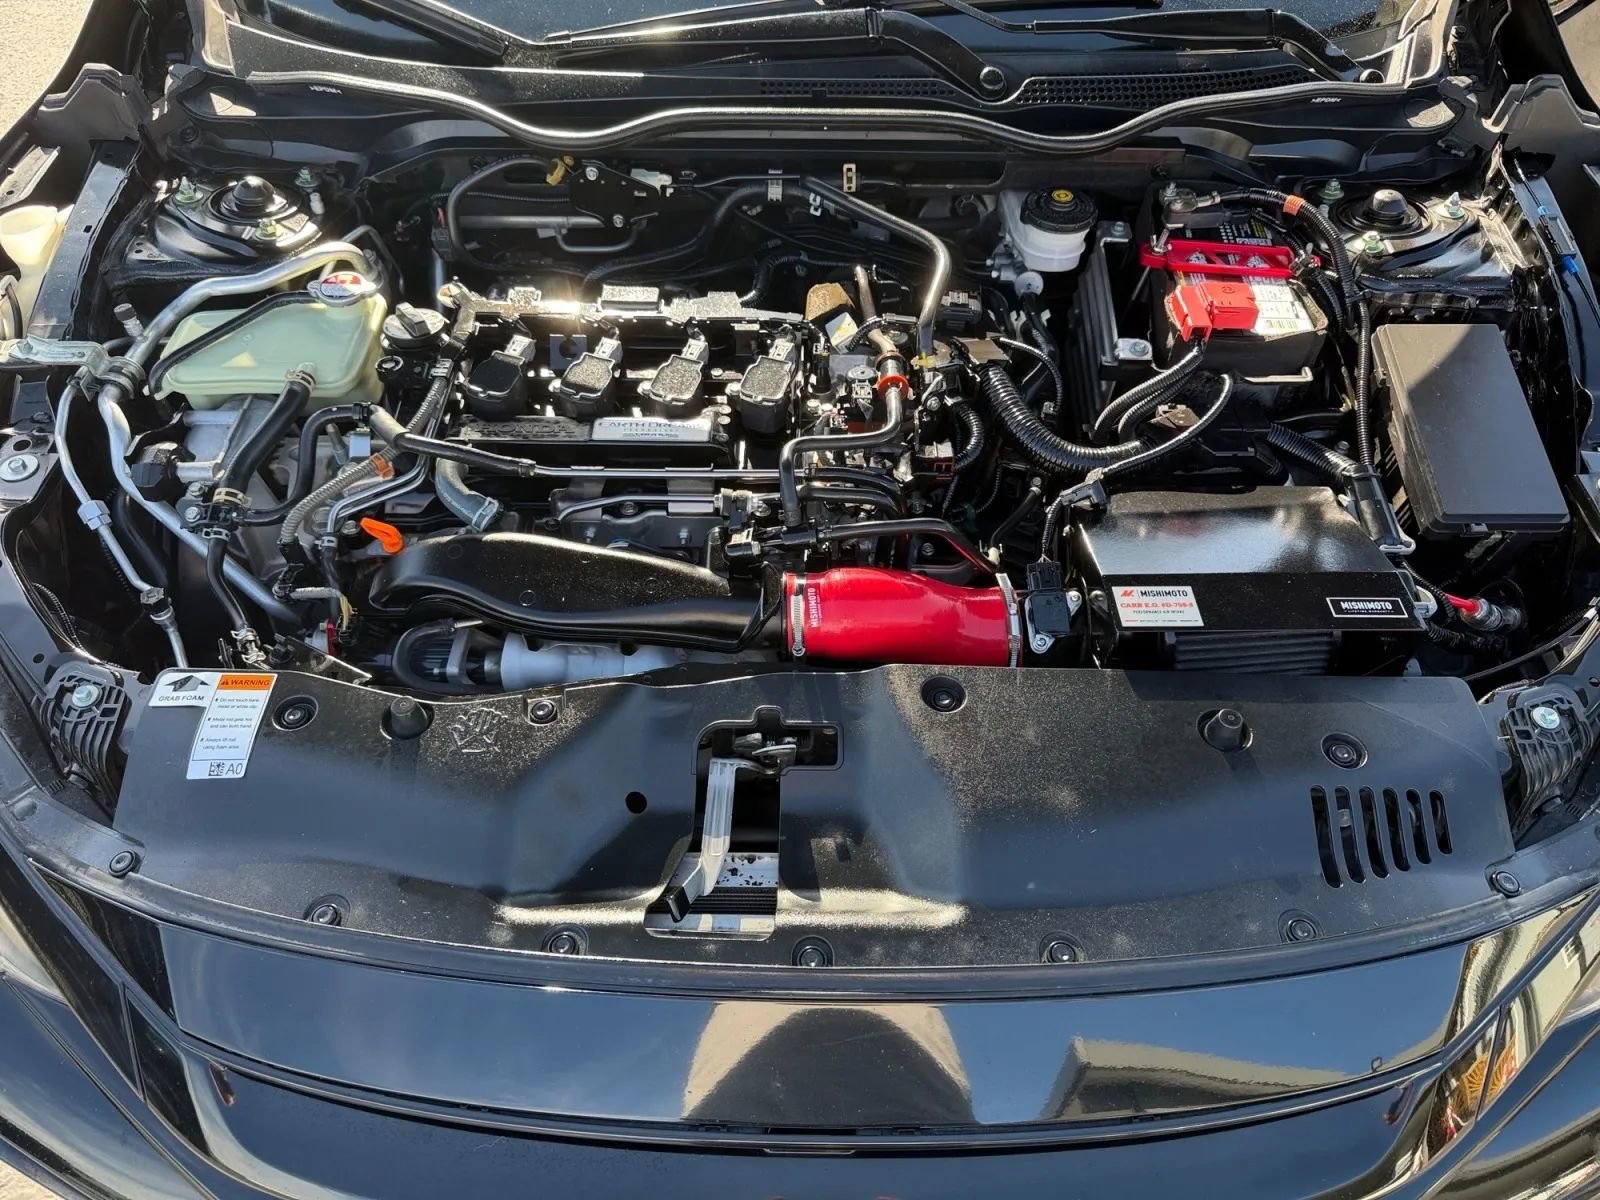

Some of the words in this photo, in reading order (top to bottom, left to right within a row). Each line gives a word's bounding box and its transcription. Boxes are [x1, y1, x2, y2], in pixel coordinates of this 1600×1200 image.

[474, 422, 576, 435] HONDA
[1140, 590, 1188, 598] MISHIMOTO
[808, 587, 818, 628] MISHIMOTO
[1340, 601, 1393, 610] MISHIMOTO
[225, 763, 243, 775] A0
